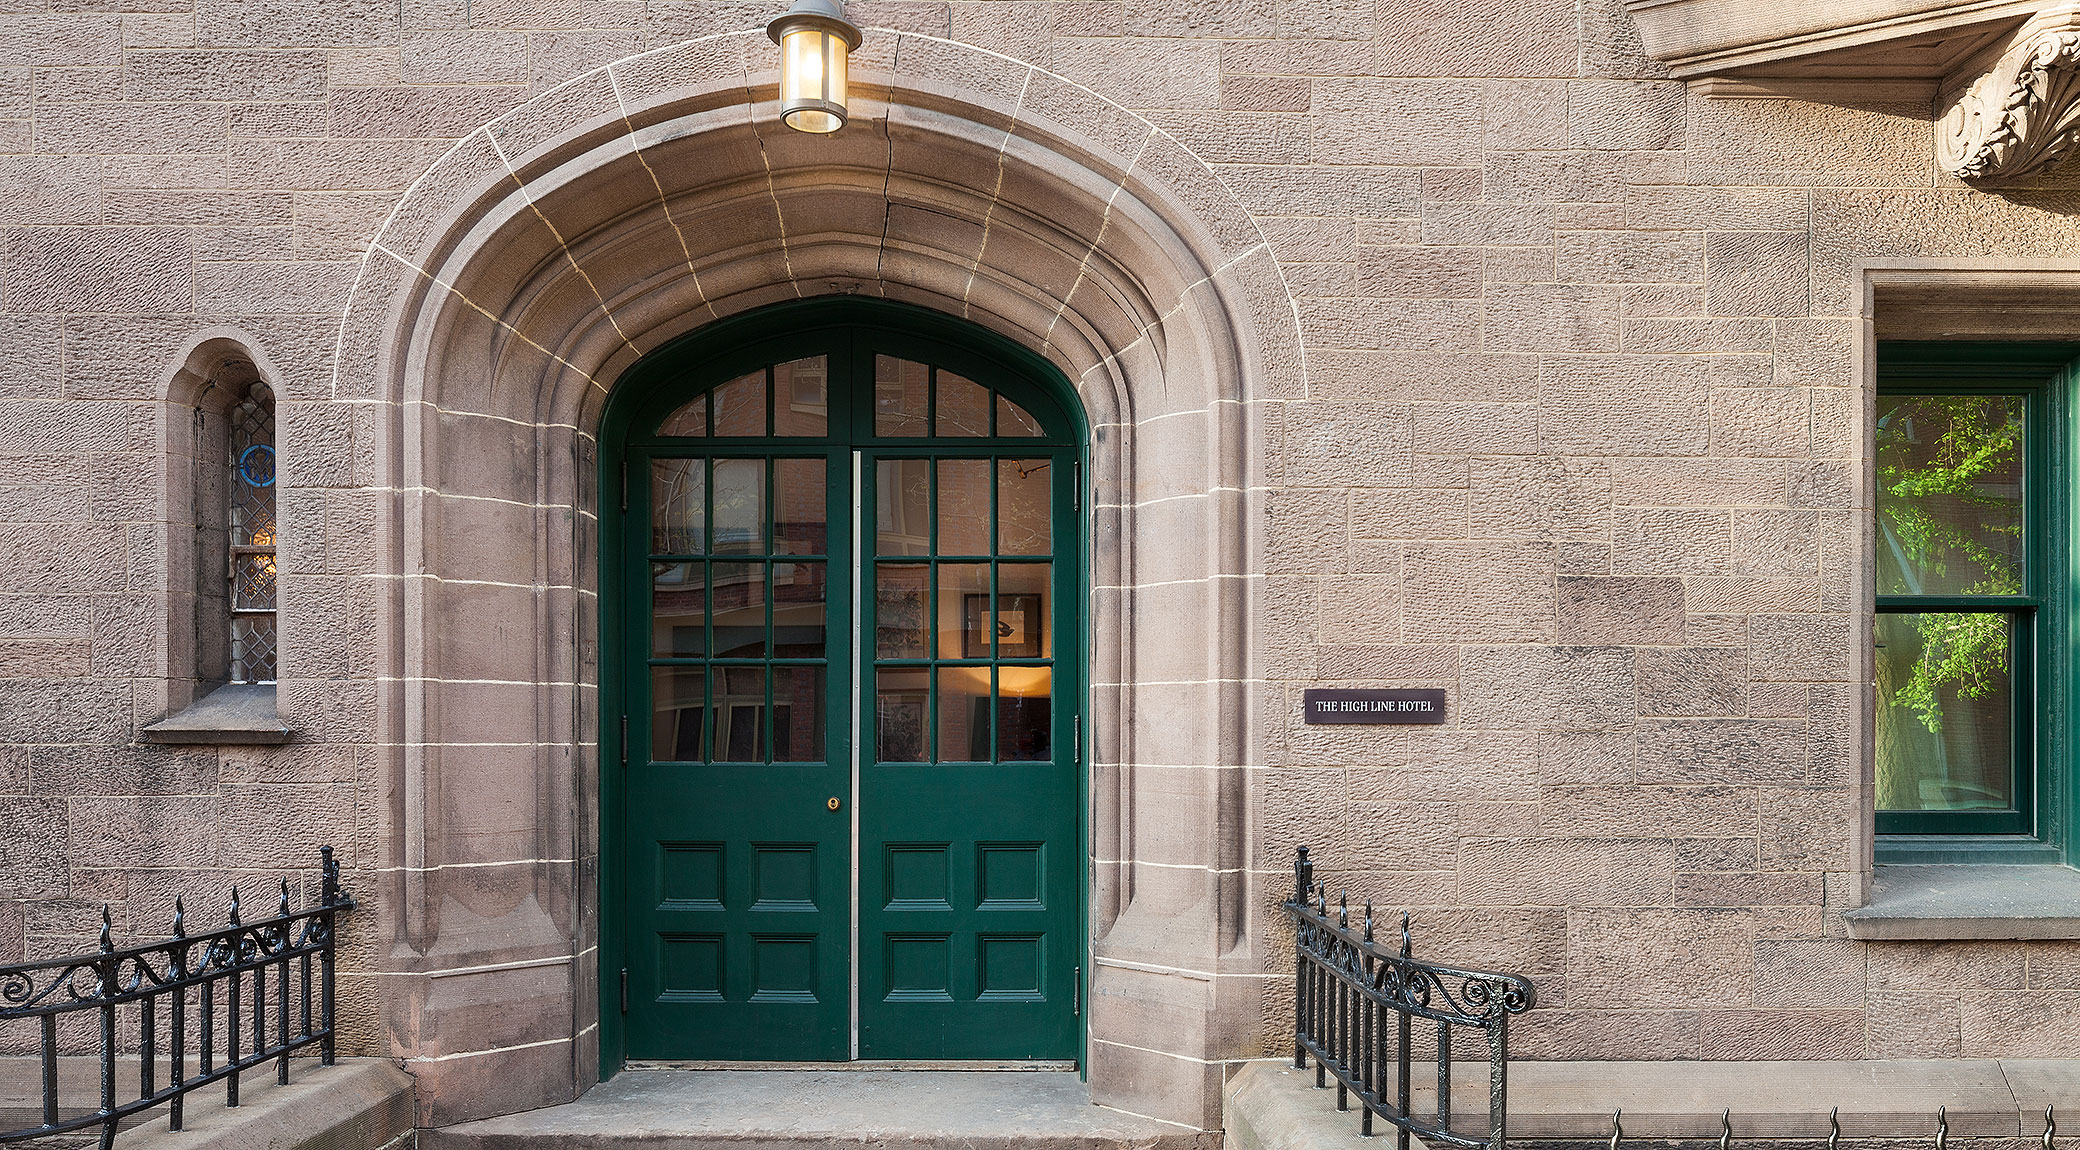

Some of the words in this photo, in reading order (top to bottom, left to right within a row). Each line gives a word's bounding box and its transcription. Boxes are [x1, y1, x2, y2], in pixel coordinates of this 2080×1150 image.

[1315, 700, 1338, 712] THE
[1340, 700, 1369, 712] HIGH
[1370, 700, 1396, 712] LINE
[1397, 700, 1435, 712] HOTEL
